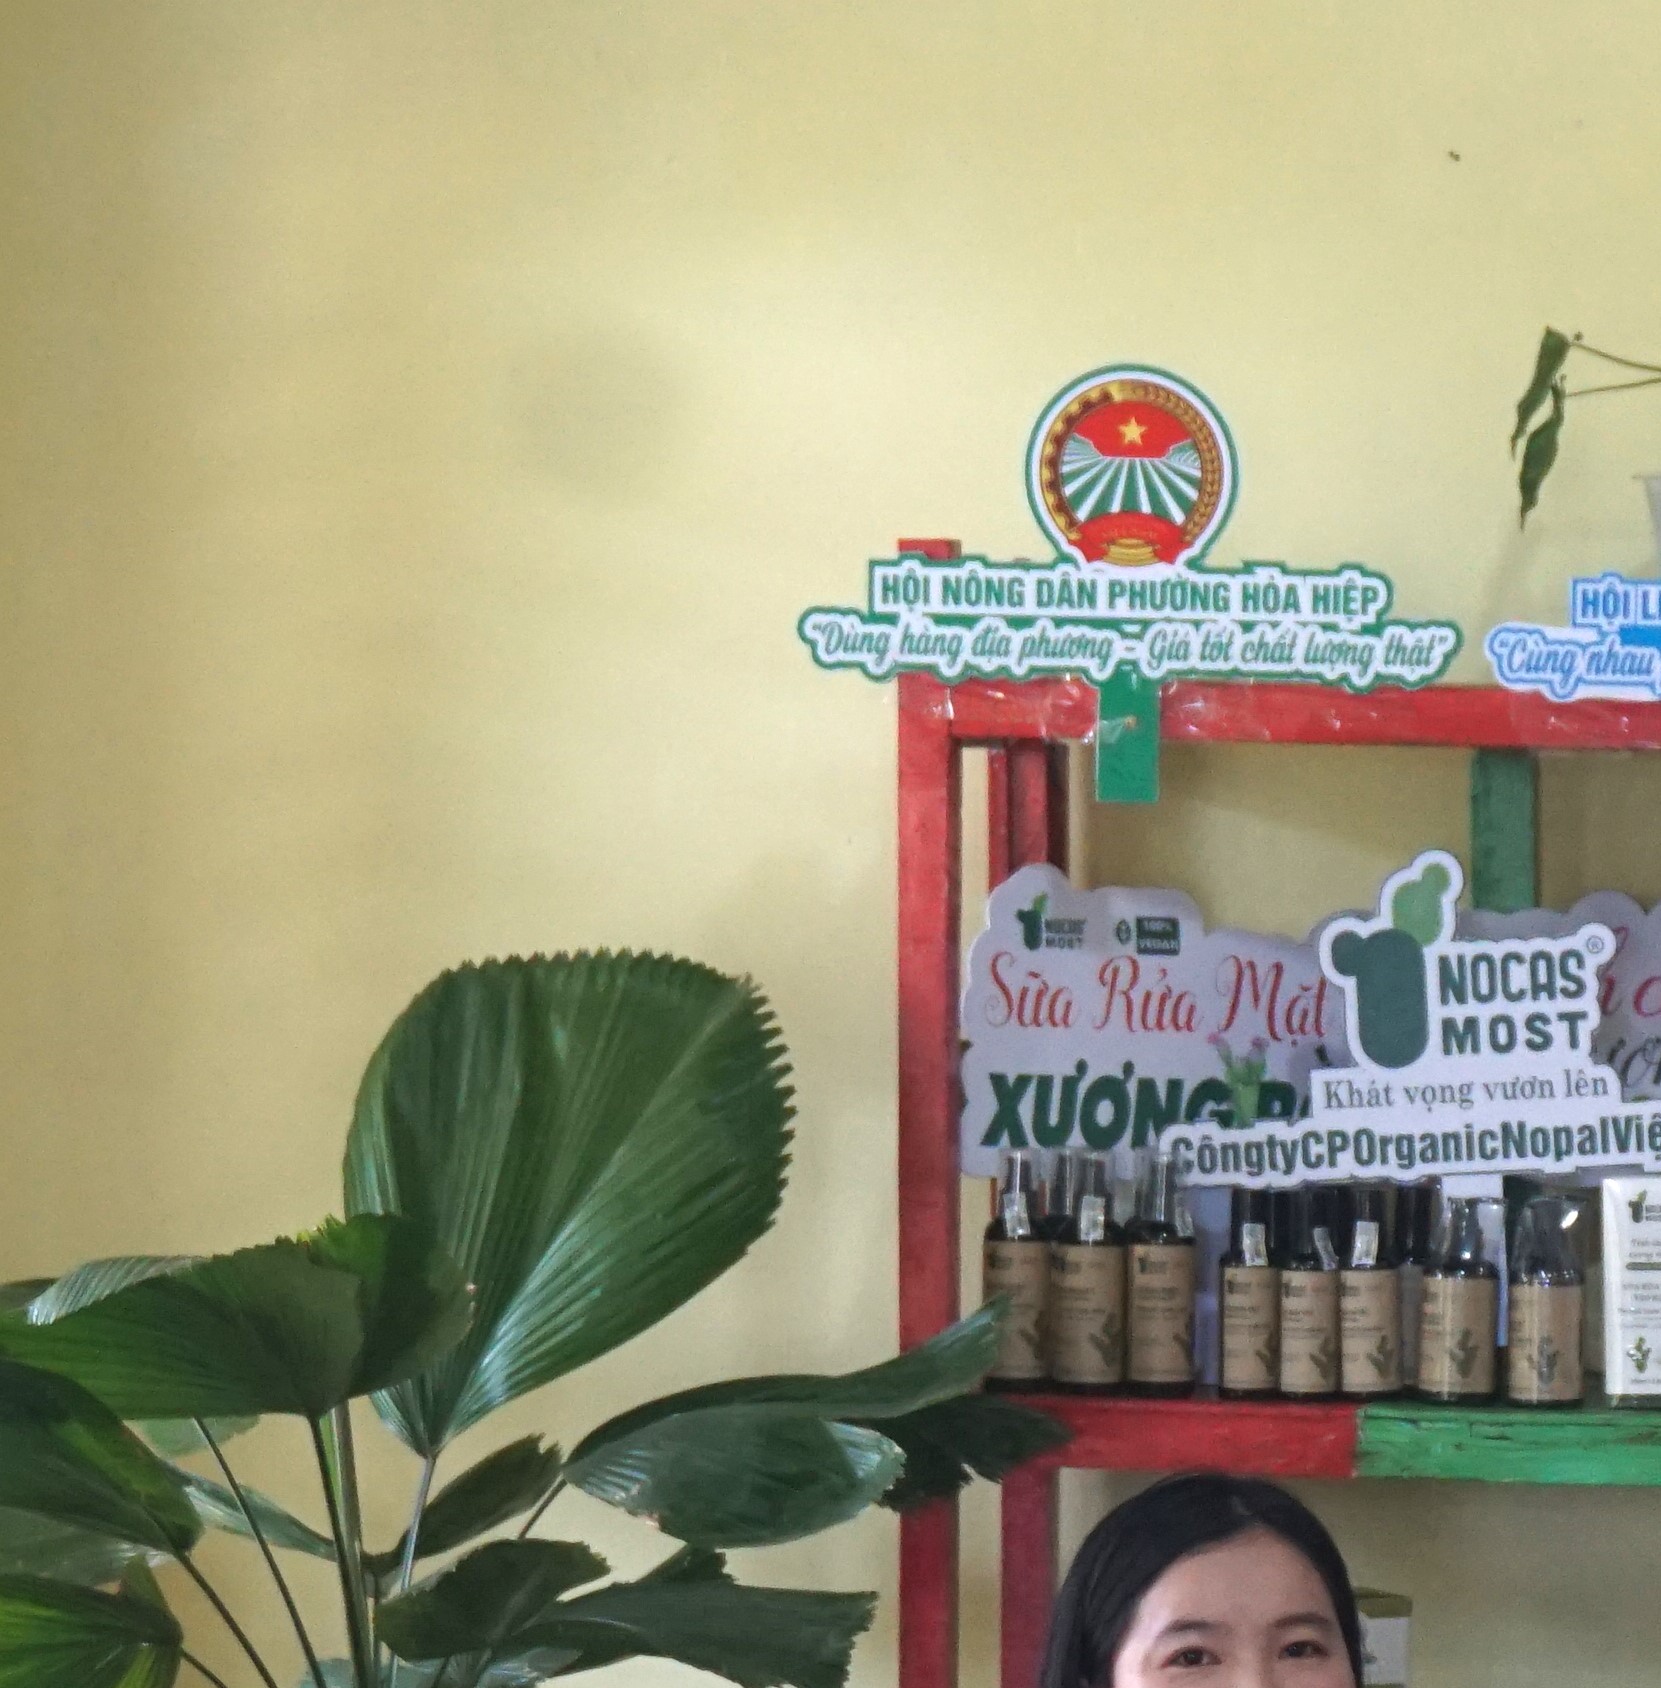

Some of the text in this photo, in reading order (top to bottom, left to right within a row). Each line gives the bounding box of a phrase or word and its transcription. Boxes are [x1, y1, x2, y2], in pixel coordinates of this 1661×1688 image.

[882, 565, 1379, 623] HỘI NÔNG DÂN PHƯỜNG HÒA HIỆP
[1581, 586, 1630, 630] HỘI
[899, 619, 960, 670] hàng
[972, 623, 1010, 664] địa
[1019, 628, 1112, 673] phương
[1147, 628, 1191, 664] Giá
[1200, 623, 1232, 663] tốt
[1242, 625, 1295, 665] chất
[1303, 629, 1375, 681] lượng
[1588, 644, 1653, 678] nhau
[985, 949, 1327, 1047] Sữa Rửa Mặt
[1438, 949, 1587, 1006] NOCAS
[1442, 1011, 1588, 1056] MOST
[1323, 1069, 1608, 1112] Khát vọng vươn lên
